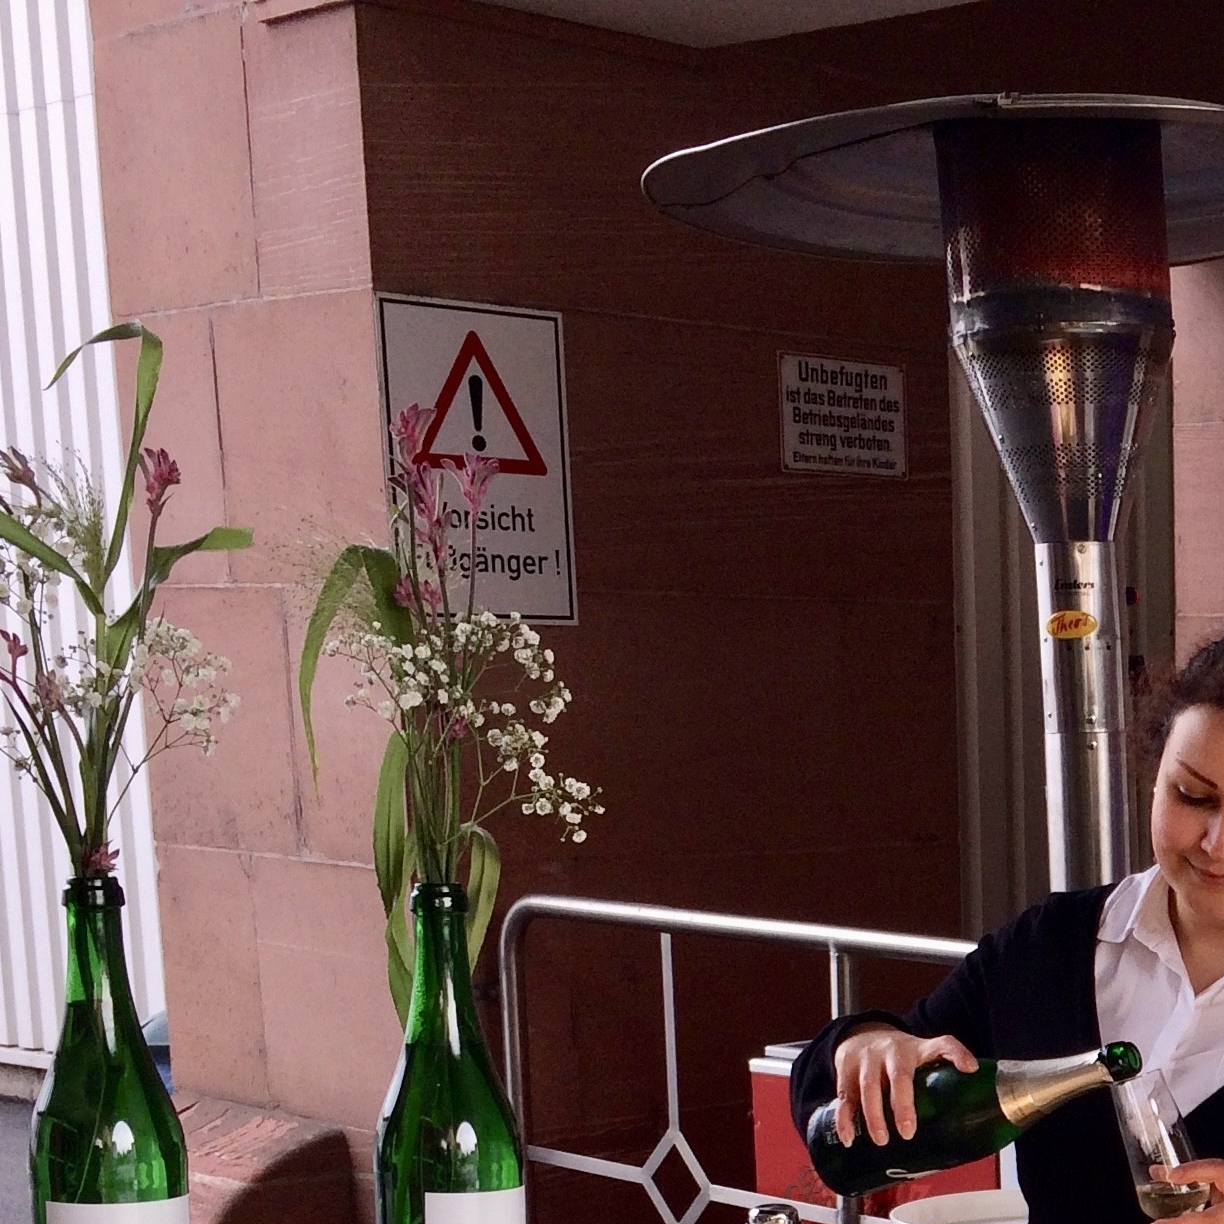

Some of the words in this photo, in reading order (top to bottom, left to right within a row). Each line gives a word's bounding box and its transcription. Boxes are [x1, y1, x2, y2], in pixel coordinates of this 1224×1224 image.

[797, 360, 888, 393] Unbefugten
[786, 386, 801, 404] ist
[803, 388, 825, 406] das
[827, 390, 877, 412] Betreten
[879, 396, 900, 413] des
[792, 406, 895, 433] Betriebsgeländes
[799, 430, 837, 452] streng
